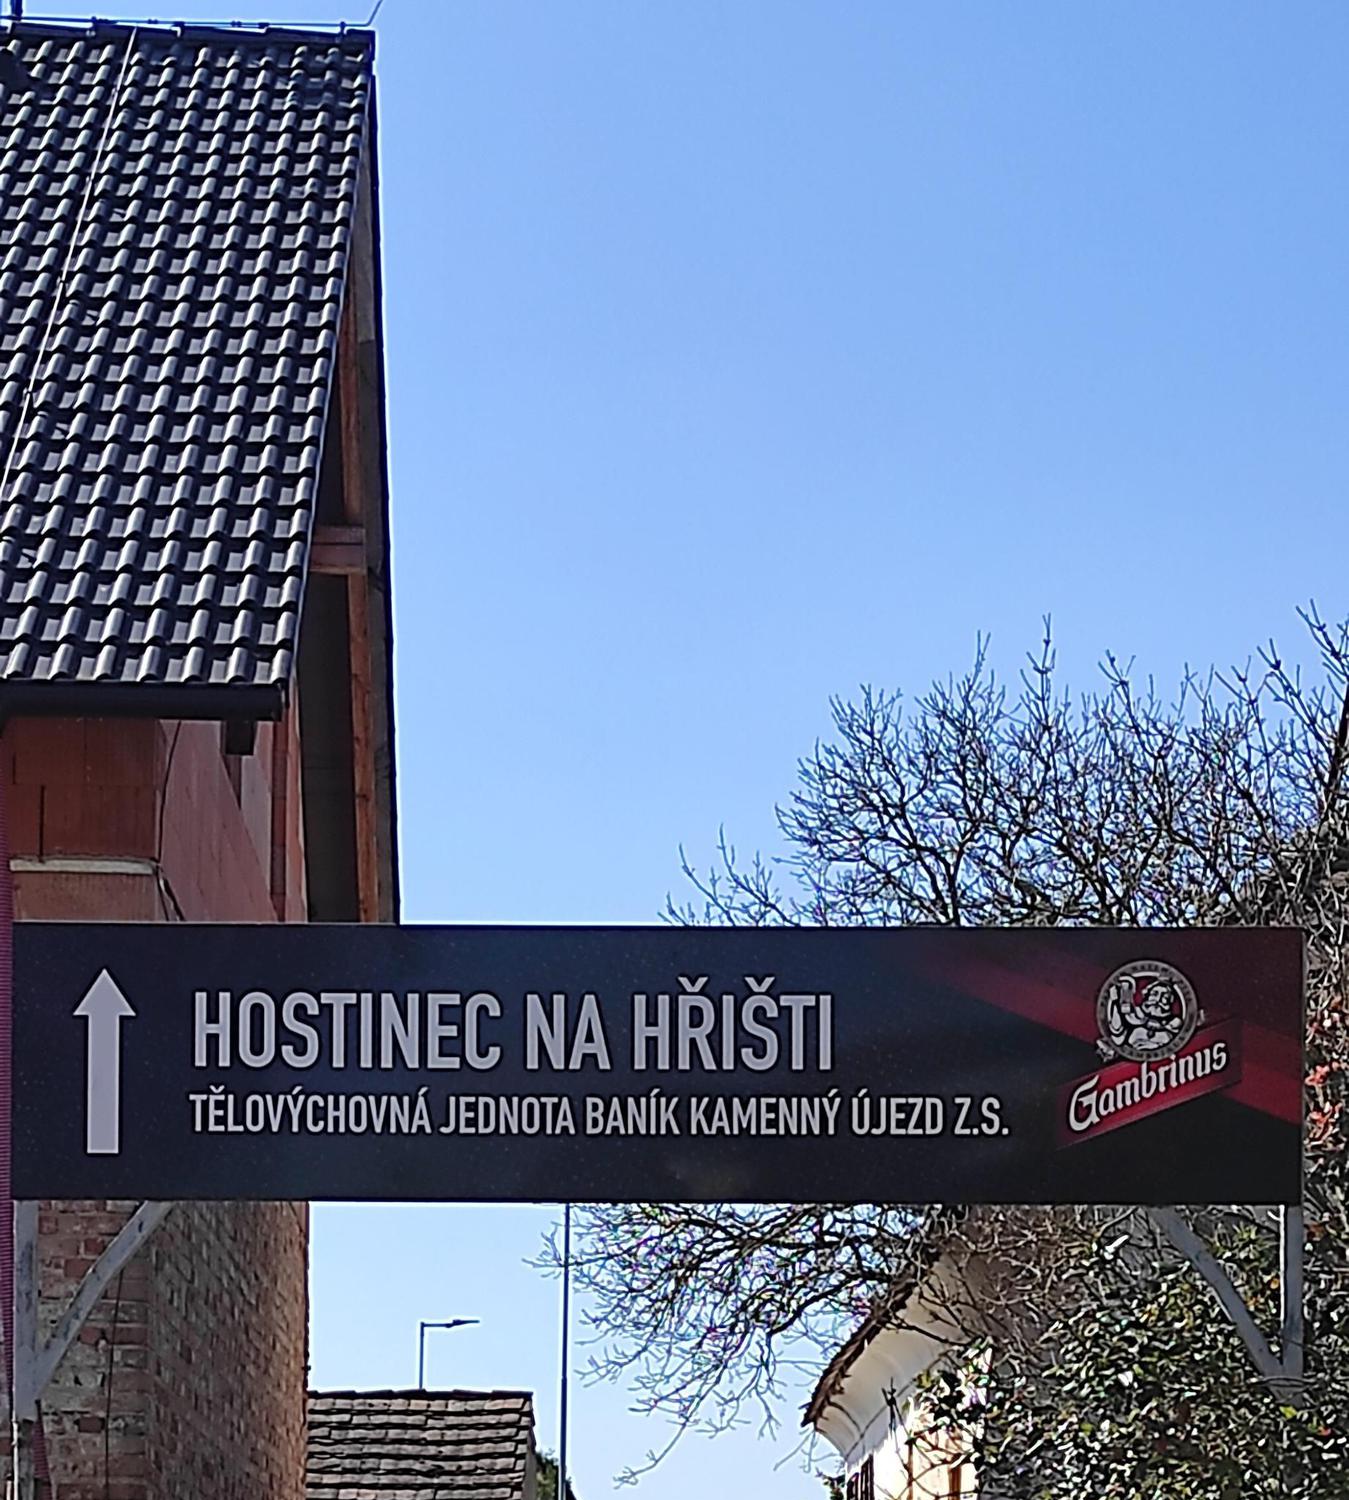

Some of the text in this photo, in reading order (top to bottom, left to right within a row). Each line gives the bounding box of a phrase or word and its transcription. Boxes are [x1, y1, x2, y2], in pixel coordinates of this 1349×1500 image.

[193, 976, 833, 1072] HOSTINEC NA HŘIŠTI
[189, 1085, 1010, 1136] TĚLOVÝCHOVNÁ JEDNOTA BANÍK KAMENNÝ ÚJEZD Z.S.
[1068, 1042, 1228, 1132] Gambrinus
